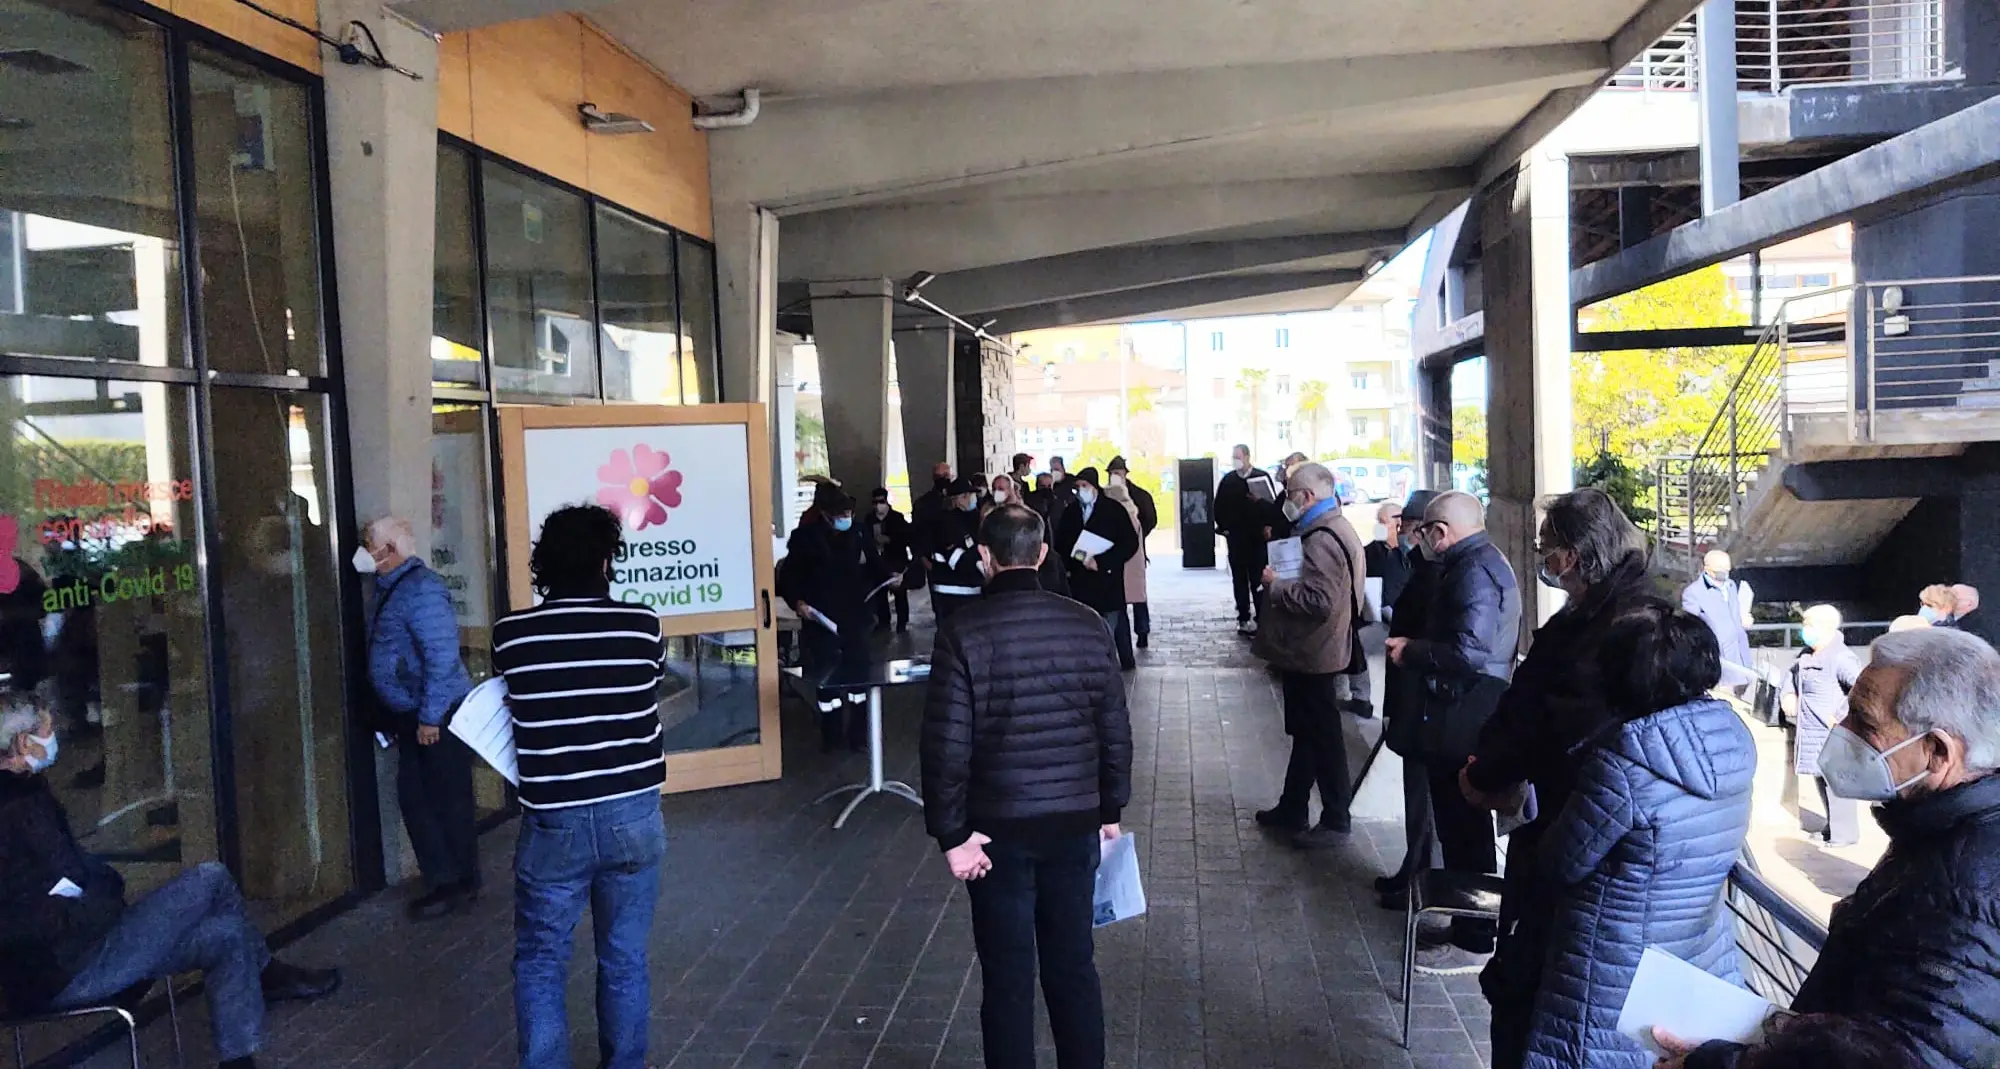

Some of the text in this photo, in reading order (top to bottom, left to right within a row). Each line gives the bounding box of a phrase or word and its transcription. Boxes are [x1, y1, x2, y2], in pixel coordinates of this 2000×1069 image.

[613, 539, 697, 563] gresso
[173, 563, 194, 591] 19
[613, 557, 720, 584] cinazioni
[621, 582, 724, 607] Covid 19
